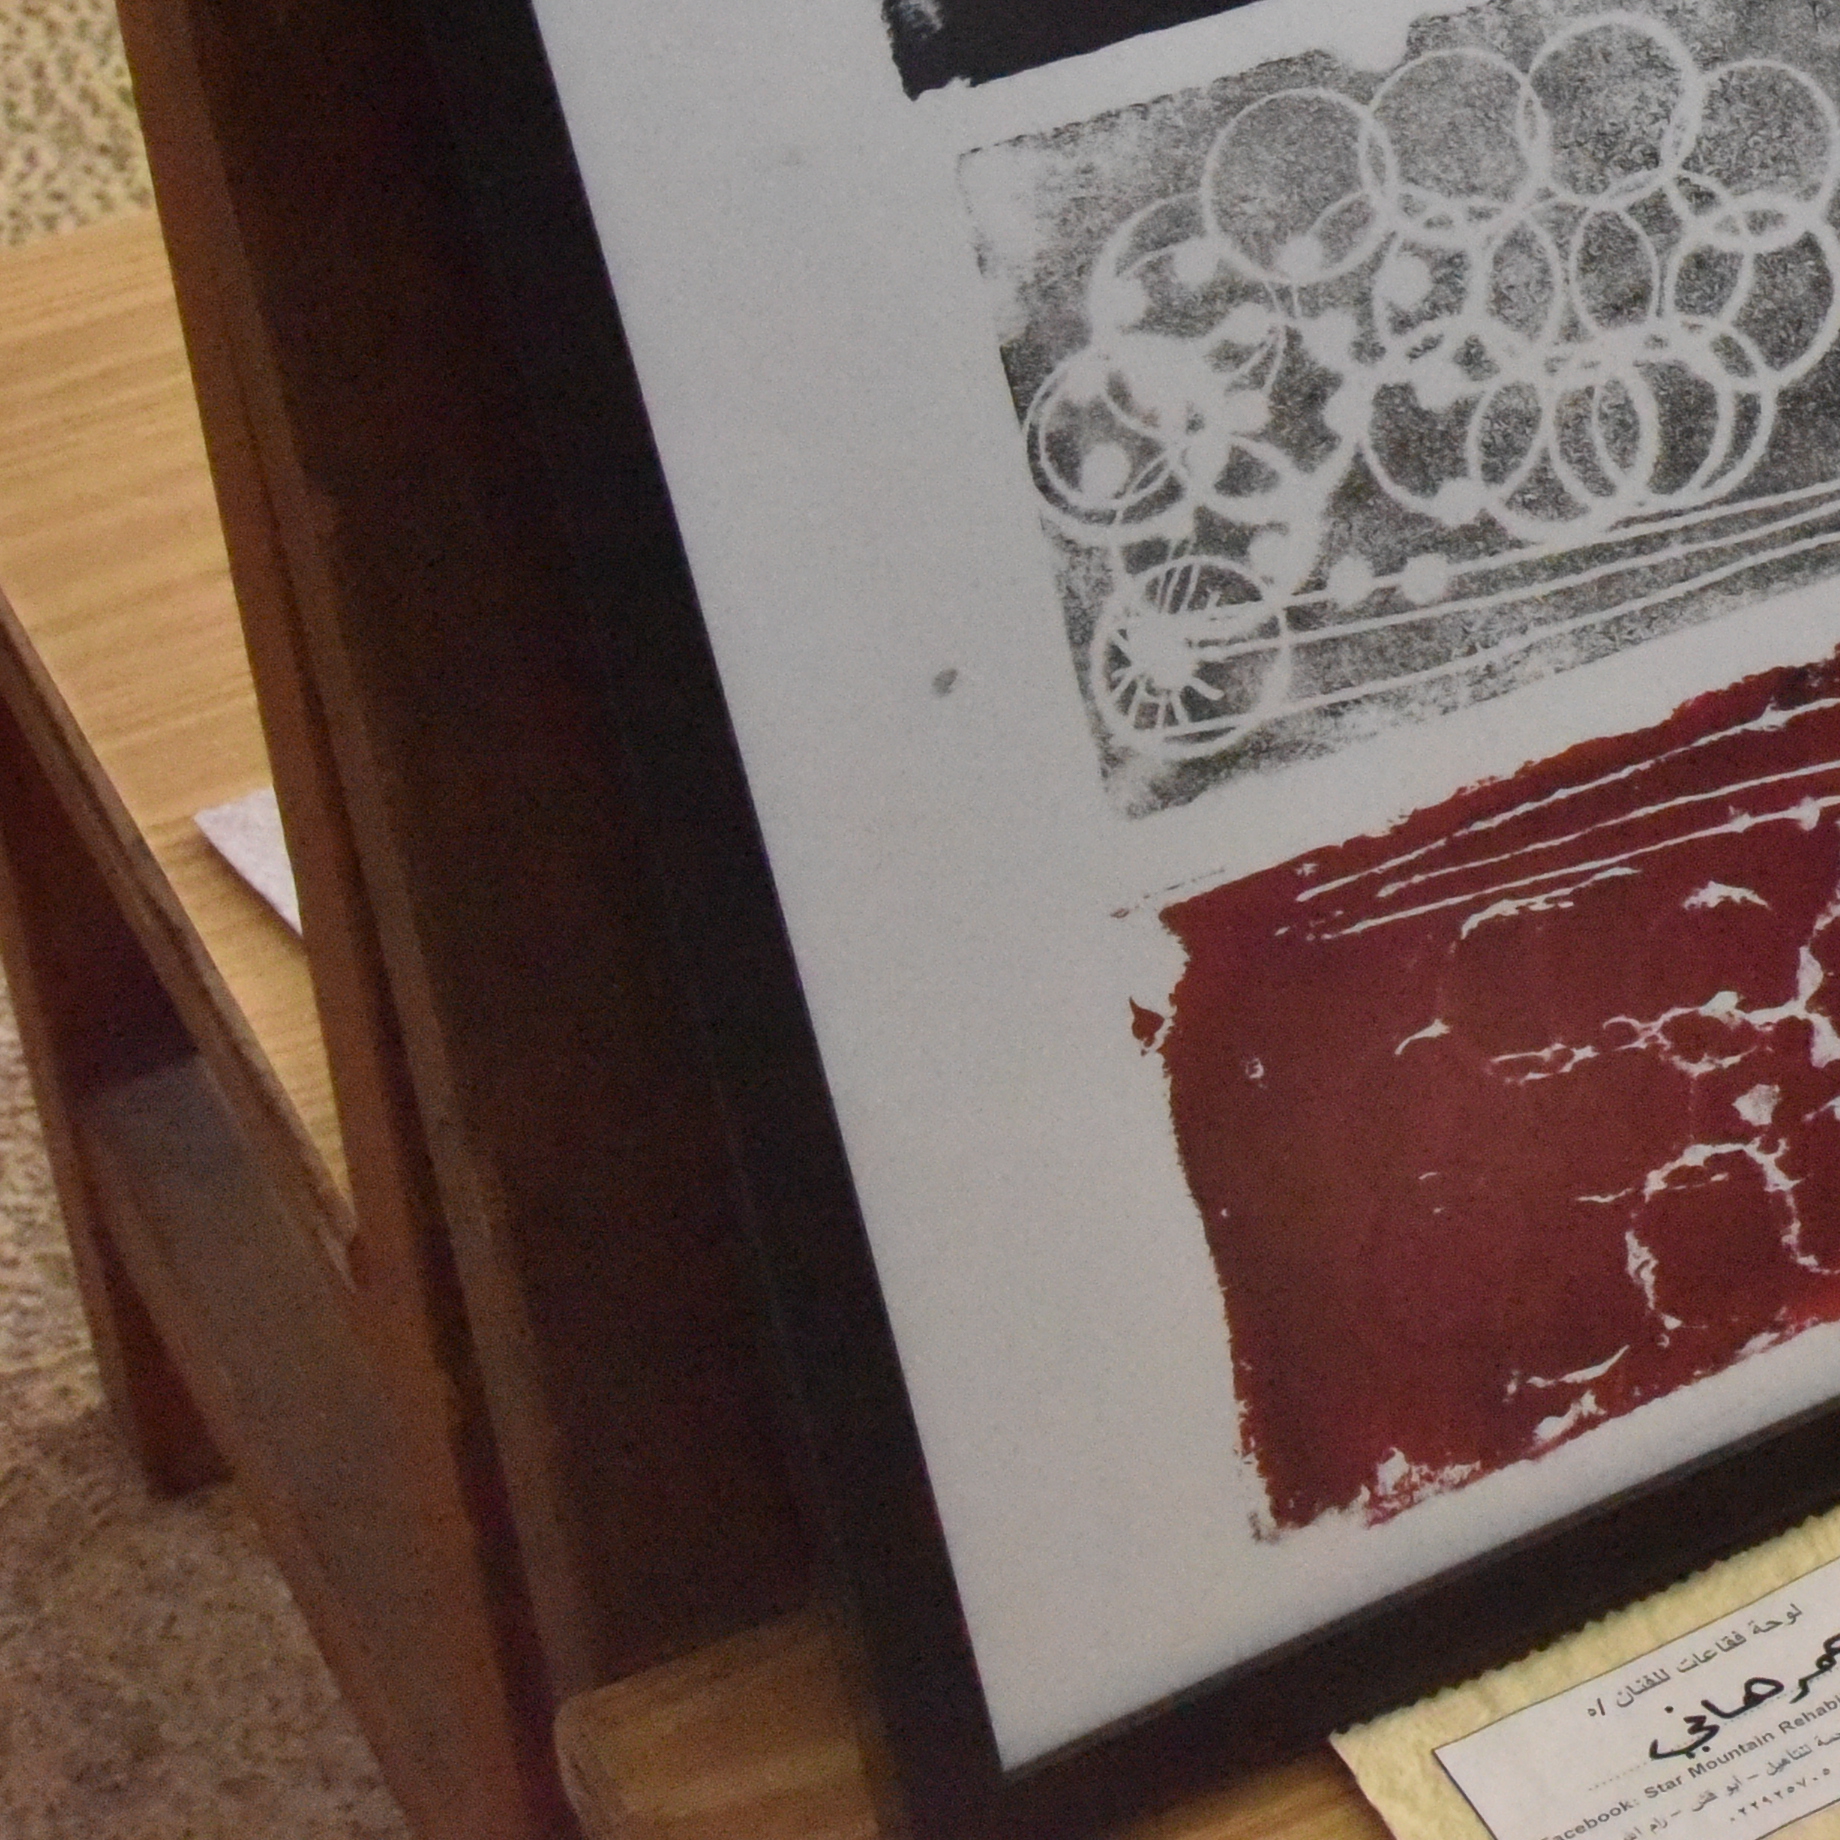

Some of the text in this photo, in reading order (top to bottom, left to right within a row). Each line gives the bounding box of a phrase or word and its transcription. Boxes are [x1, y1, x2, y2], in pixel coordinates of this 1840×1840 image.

[1752, 1603, 1803, 1635] لوحة
[1676, 1630, 1747, 1674] فقاعات
[1615, 1668, 1671, 1709] للفنان
[1644, 1775, 1683, 1799] Star
[1687, 1731, 1775, 1779] Mountain
